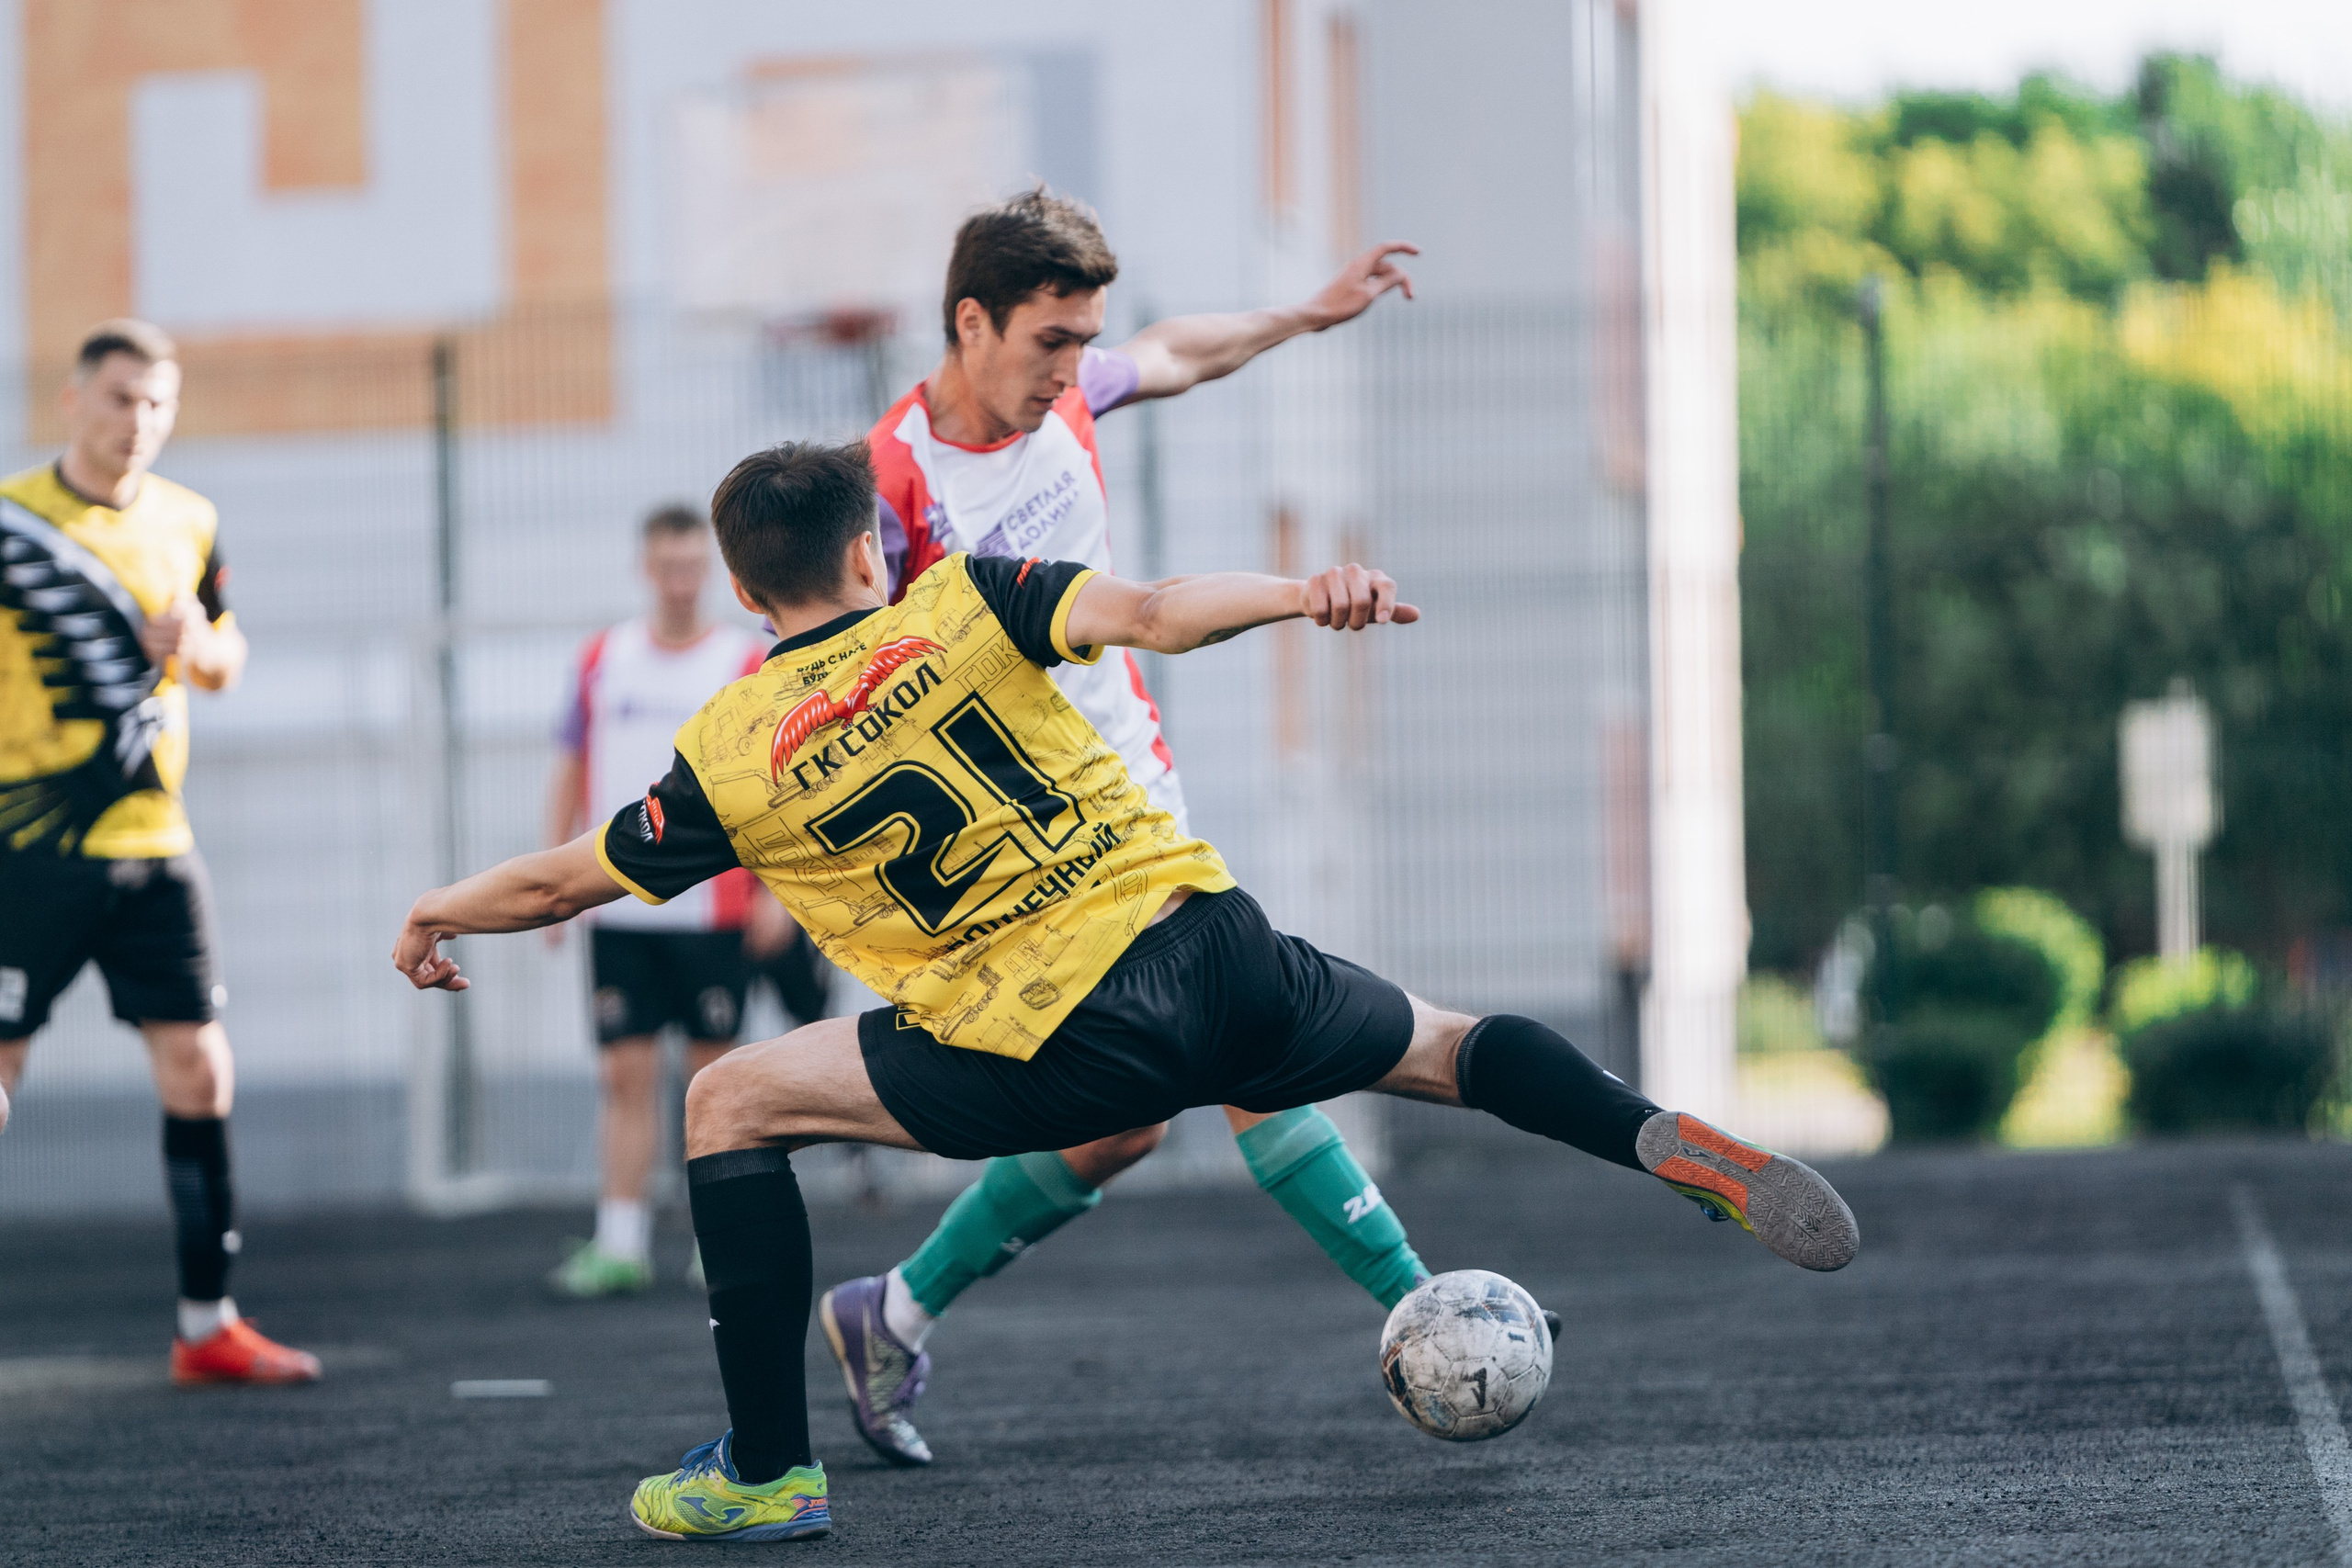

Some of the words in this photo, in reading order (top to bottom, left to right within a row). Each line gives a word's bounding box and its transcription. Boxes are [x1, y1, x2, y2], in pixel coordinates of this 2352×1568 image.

[1017, 491, 1078, 551] ДОЛИН
[791, 745, 842, 791] ГК
[836, 660, 943, 757] СОКОЛ
[638, 798, 654, 842] ОКОЛ
[803, 691, 1087, 938] 21
[947, 822, 1121, 952] ОНЕЧНЫЙ
